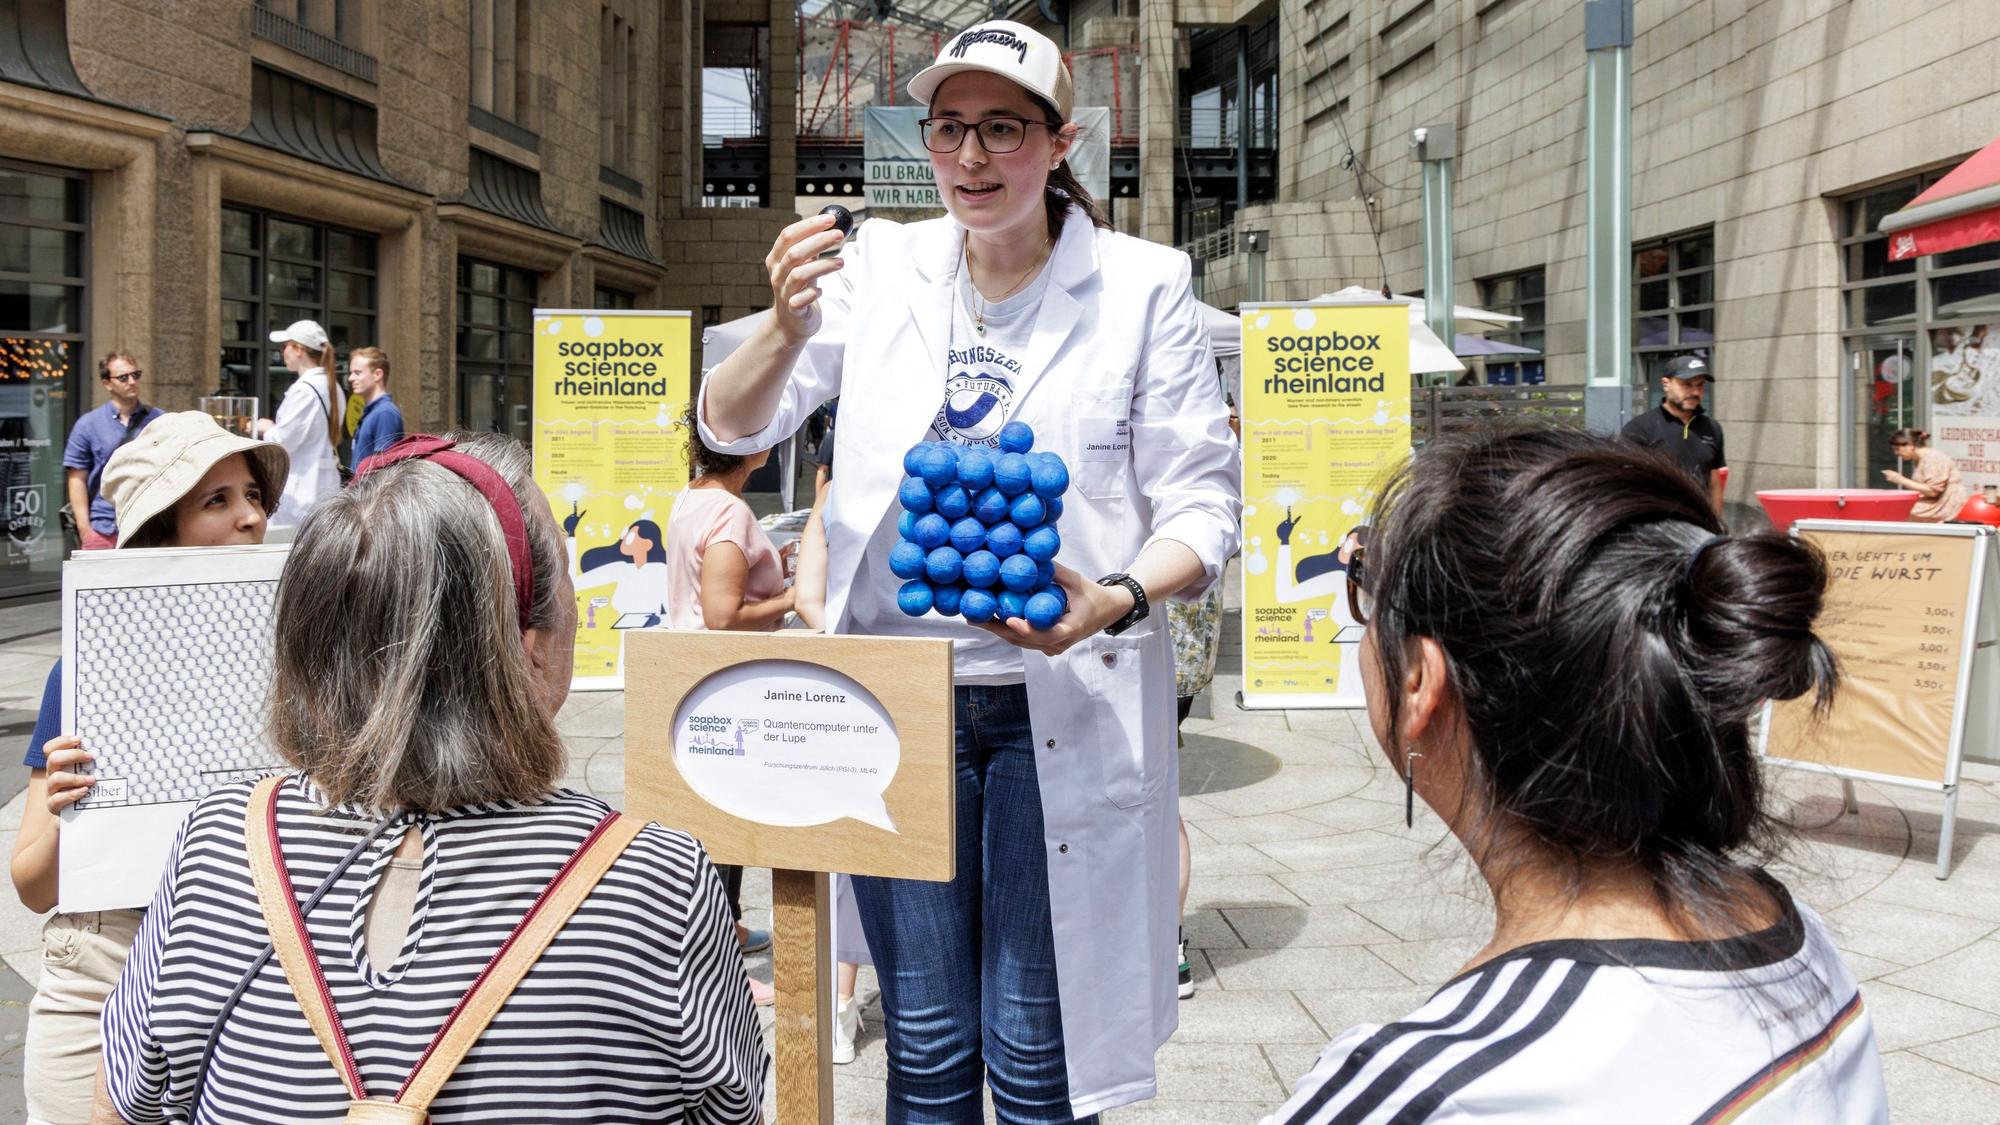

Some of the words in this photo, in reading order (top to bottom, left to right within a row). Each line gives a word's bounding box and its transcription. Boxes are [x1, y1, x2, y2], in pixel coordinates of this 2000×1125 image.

[872, 165, 891, 180] DU
[873, 189, 900, 204] WIR
[558, 338, 664, 361] soapbox
[1267, 331, 1381, 355] soapbox
[564, 358, 657, 376] science
[1274, 353, 1374, 373] science
[555, 377, 667, 396] rheinland
[964, 381, 1001, 396] FUTURA
[1264, 372, 1385, 394] rheinland
[1968, 443, 1984, 457] DIE
[14, 490, 41, 515] 50
[8, 515, 46, 532] OSPREY
[1856, 551, 1906, 561] GEHT'S
[1913, 552, 1932, 562] UM
[1832, 566, 1863, 580] DIE
[1871, 566, 1942, 581] WURST
[1255, 606, 1297, 616] soapbox
[1255, 614, 1292, 622] science
[1254, 634, 1299, 643] rheinland
[764, 690, 802, 701] Janine
[805, 691, 846, 703] Lorenz
[689, 715, 732, 725] soapbox
[689, 722, 727, 733] science
[763, 718, 851, 733] Quantencomputer
[853, 724, 879, 734] unter
[763, 732, 779, 741] der
[782, 733, 807, 744] Lupe
[689, 745, 734, 756] rheinland
[764, 761, 818, 770] Forschungszentrum
